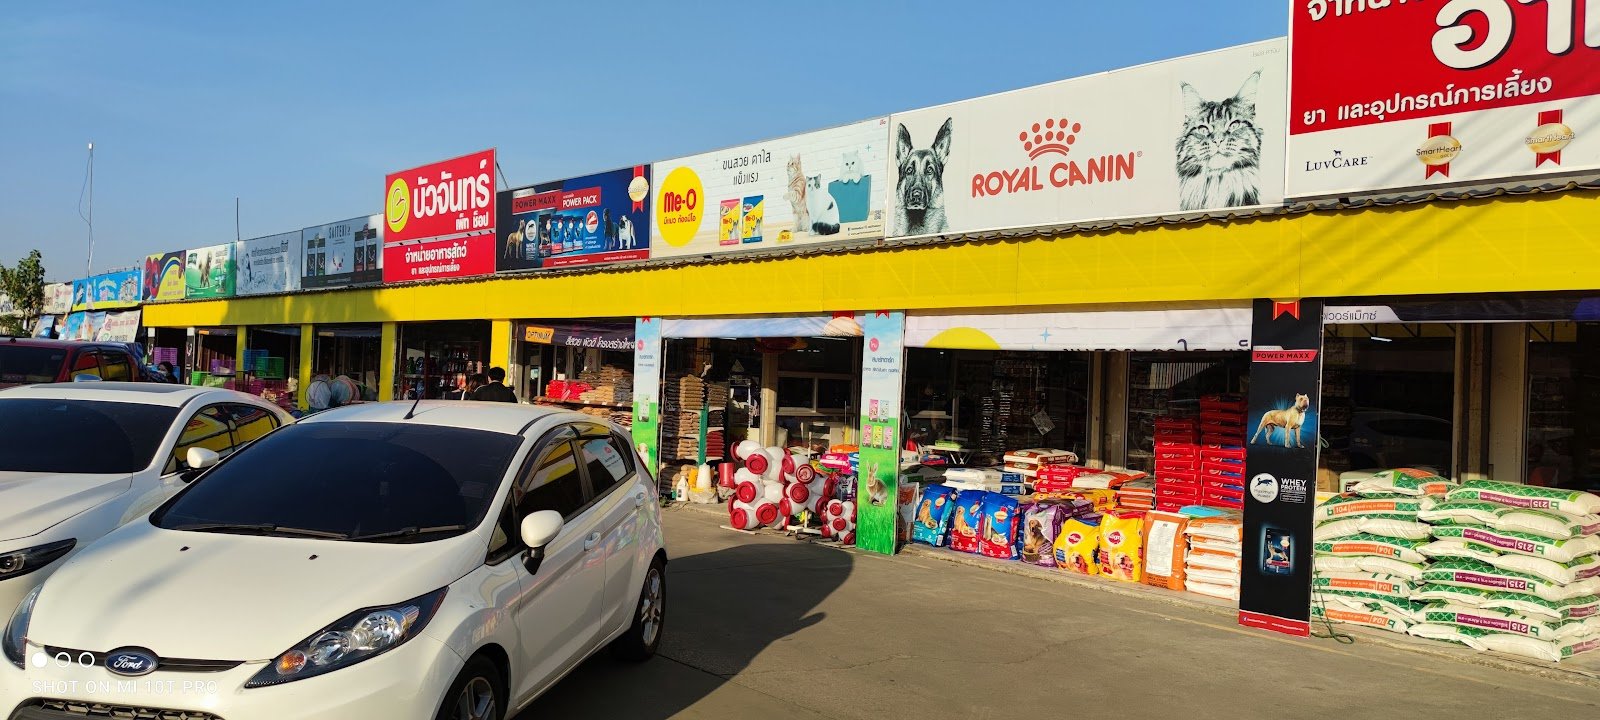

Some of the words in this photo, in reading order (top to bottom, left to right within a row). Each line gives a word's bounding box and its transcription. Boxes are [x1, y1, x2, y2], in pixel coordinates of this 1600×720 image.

[1303, 108, 1325, 125] ยา
[1338, 68, 1552, 122] และอุปกรณ์การเลี้ยง
[1525, 132, 1575, 144] SmartHeart
[1415, 144, 1462, 157] SmartHeart
[722, 155, 749, 171] ขนสวย
[751, 149, 771, 166] ตาใส
[733, 171, 759, 186] แข็งแรง
[971, 165, 1044, 198] ROYAL
[1049, 151, 1135, 188] CANIN
[413, 159, 490, 219] บัวจันทร์
[515, 198, 537, 209] POWER
[538, 195, 556, 205] MAXX
[563, 197, 582, 208] POWER
[582, 195, 597, 205] PACK
[473, 210, 489, 229] ช็อป
[405, 240, 467, 264] จำหน่ายอาหารสัตว์
[1256, 352, 1285, 360] POWER
[1280, 477, 1307, 487] WHEY
[1280, 484, 1307, 492] PROTEIN
[1335, 505, 1349, 514] 104
[1533, 500, 1548, 509] 215
[1378, 545, 1392, 555] 104
[1516, 541, 1534, 552] 215
[1378, 583, 1391, 592] 104
[1508, 580, 1525, 590] 215
[1372, 616, 1387, 626] 104
[1511, 621, 1527, 633] 215
[113, 654, 142, 671] Ford
